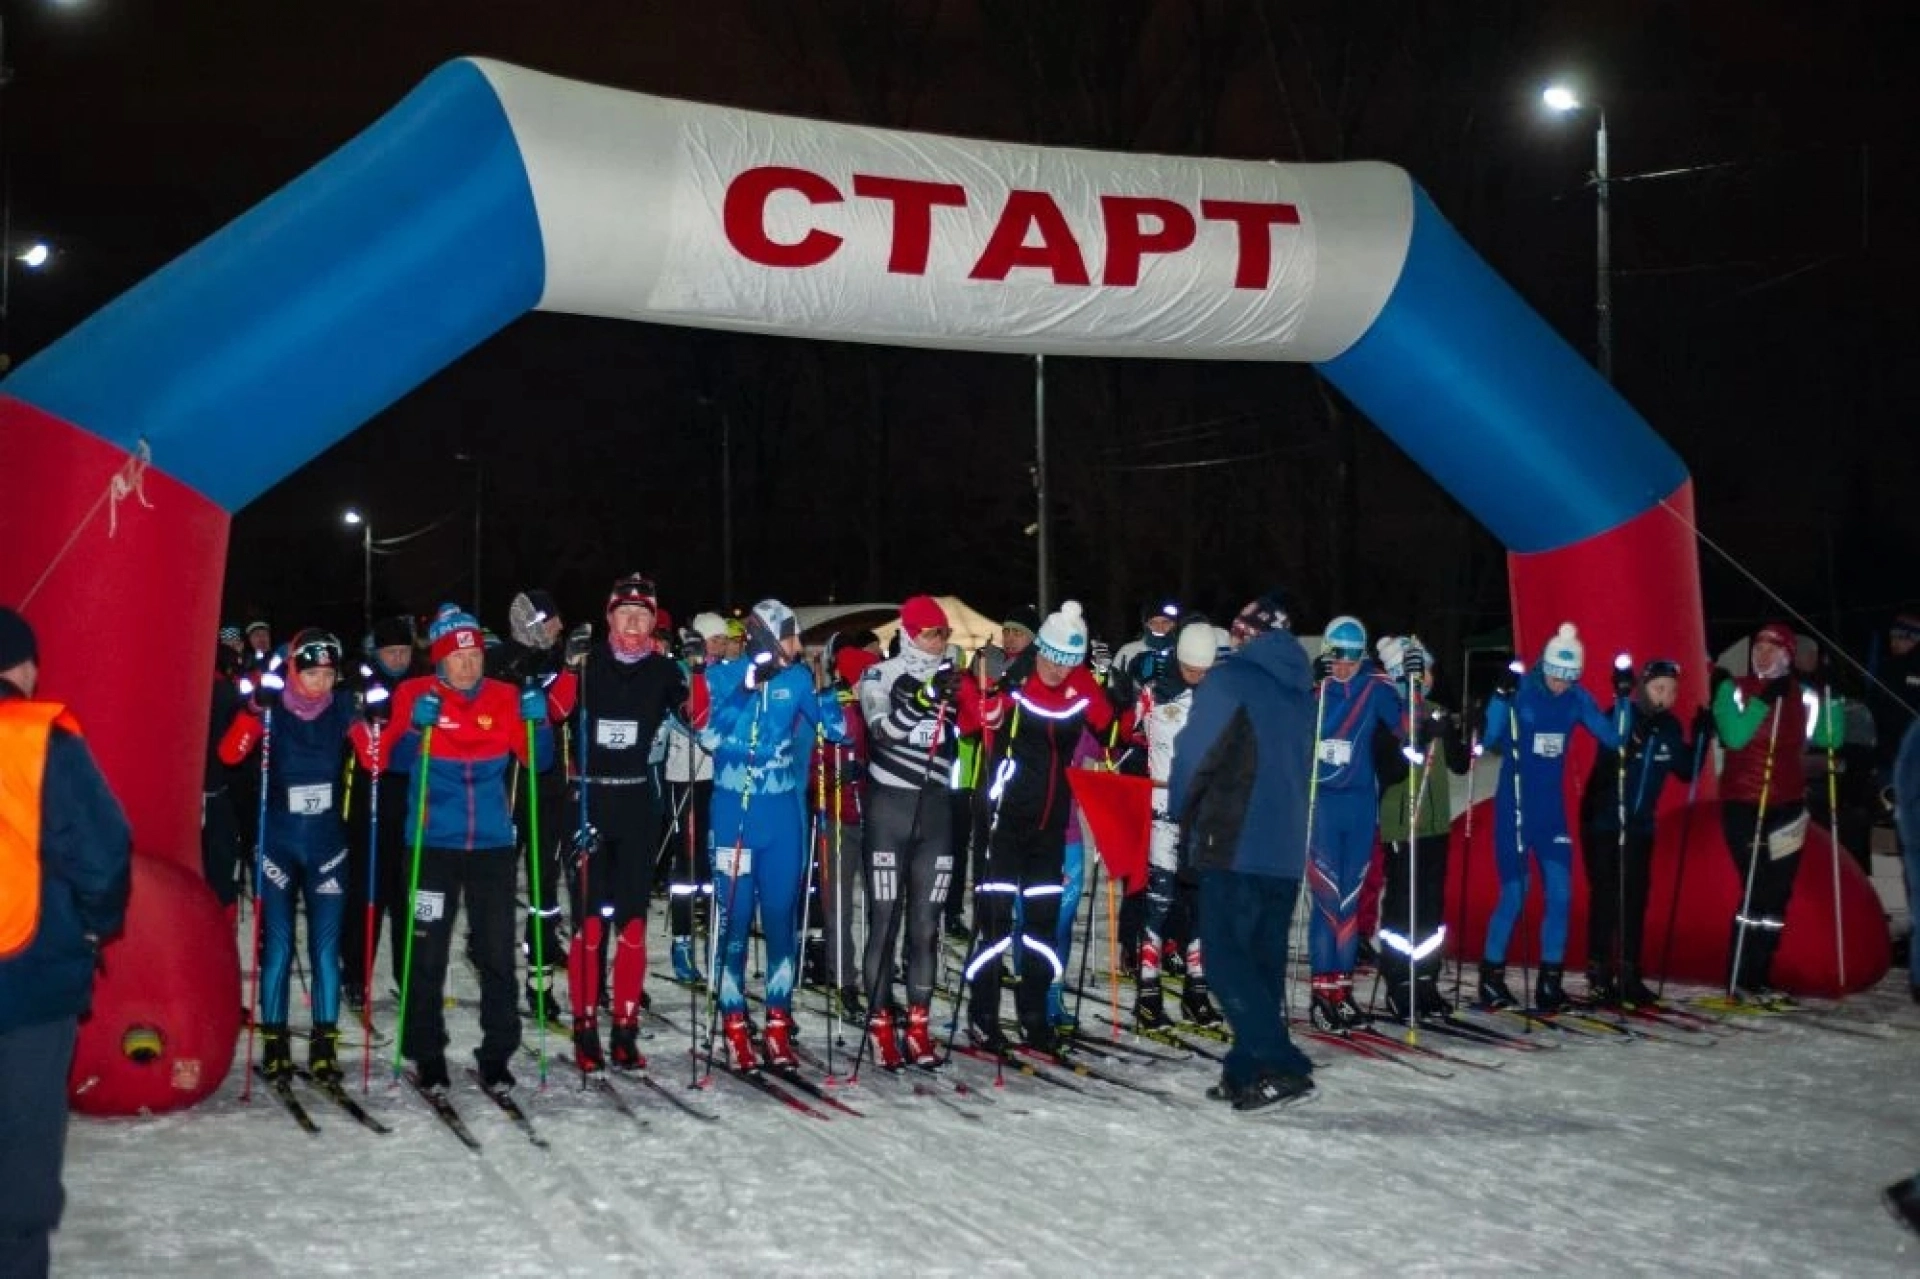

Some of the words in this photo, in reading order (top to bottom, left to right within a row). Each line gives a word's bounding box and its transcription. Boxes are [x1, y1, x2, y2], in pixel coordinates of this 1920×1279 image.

[723, 165, 1300, 290] СТАРТ
[609, 733, 625, 744] 22
[257, 848, 290, 890] KOIL
[416, 902, 432, 917] 28
